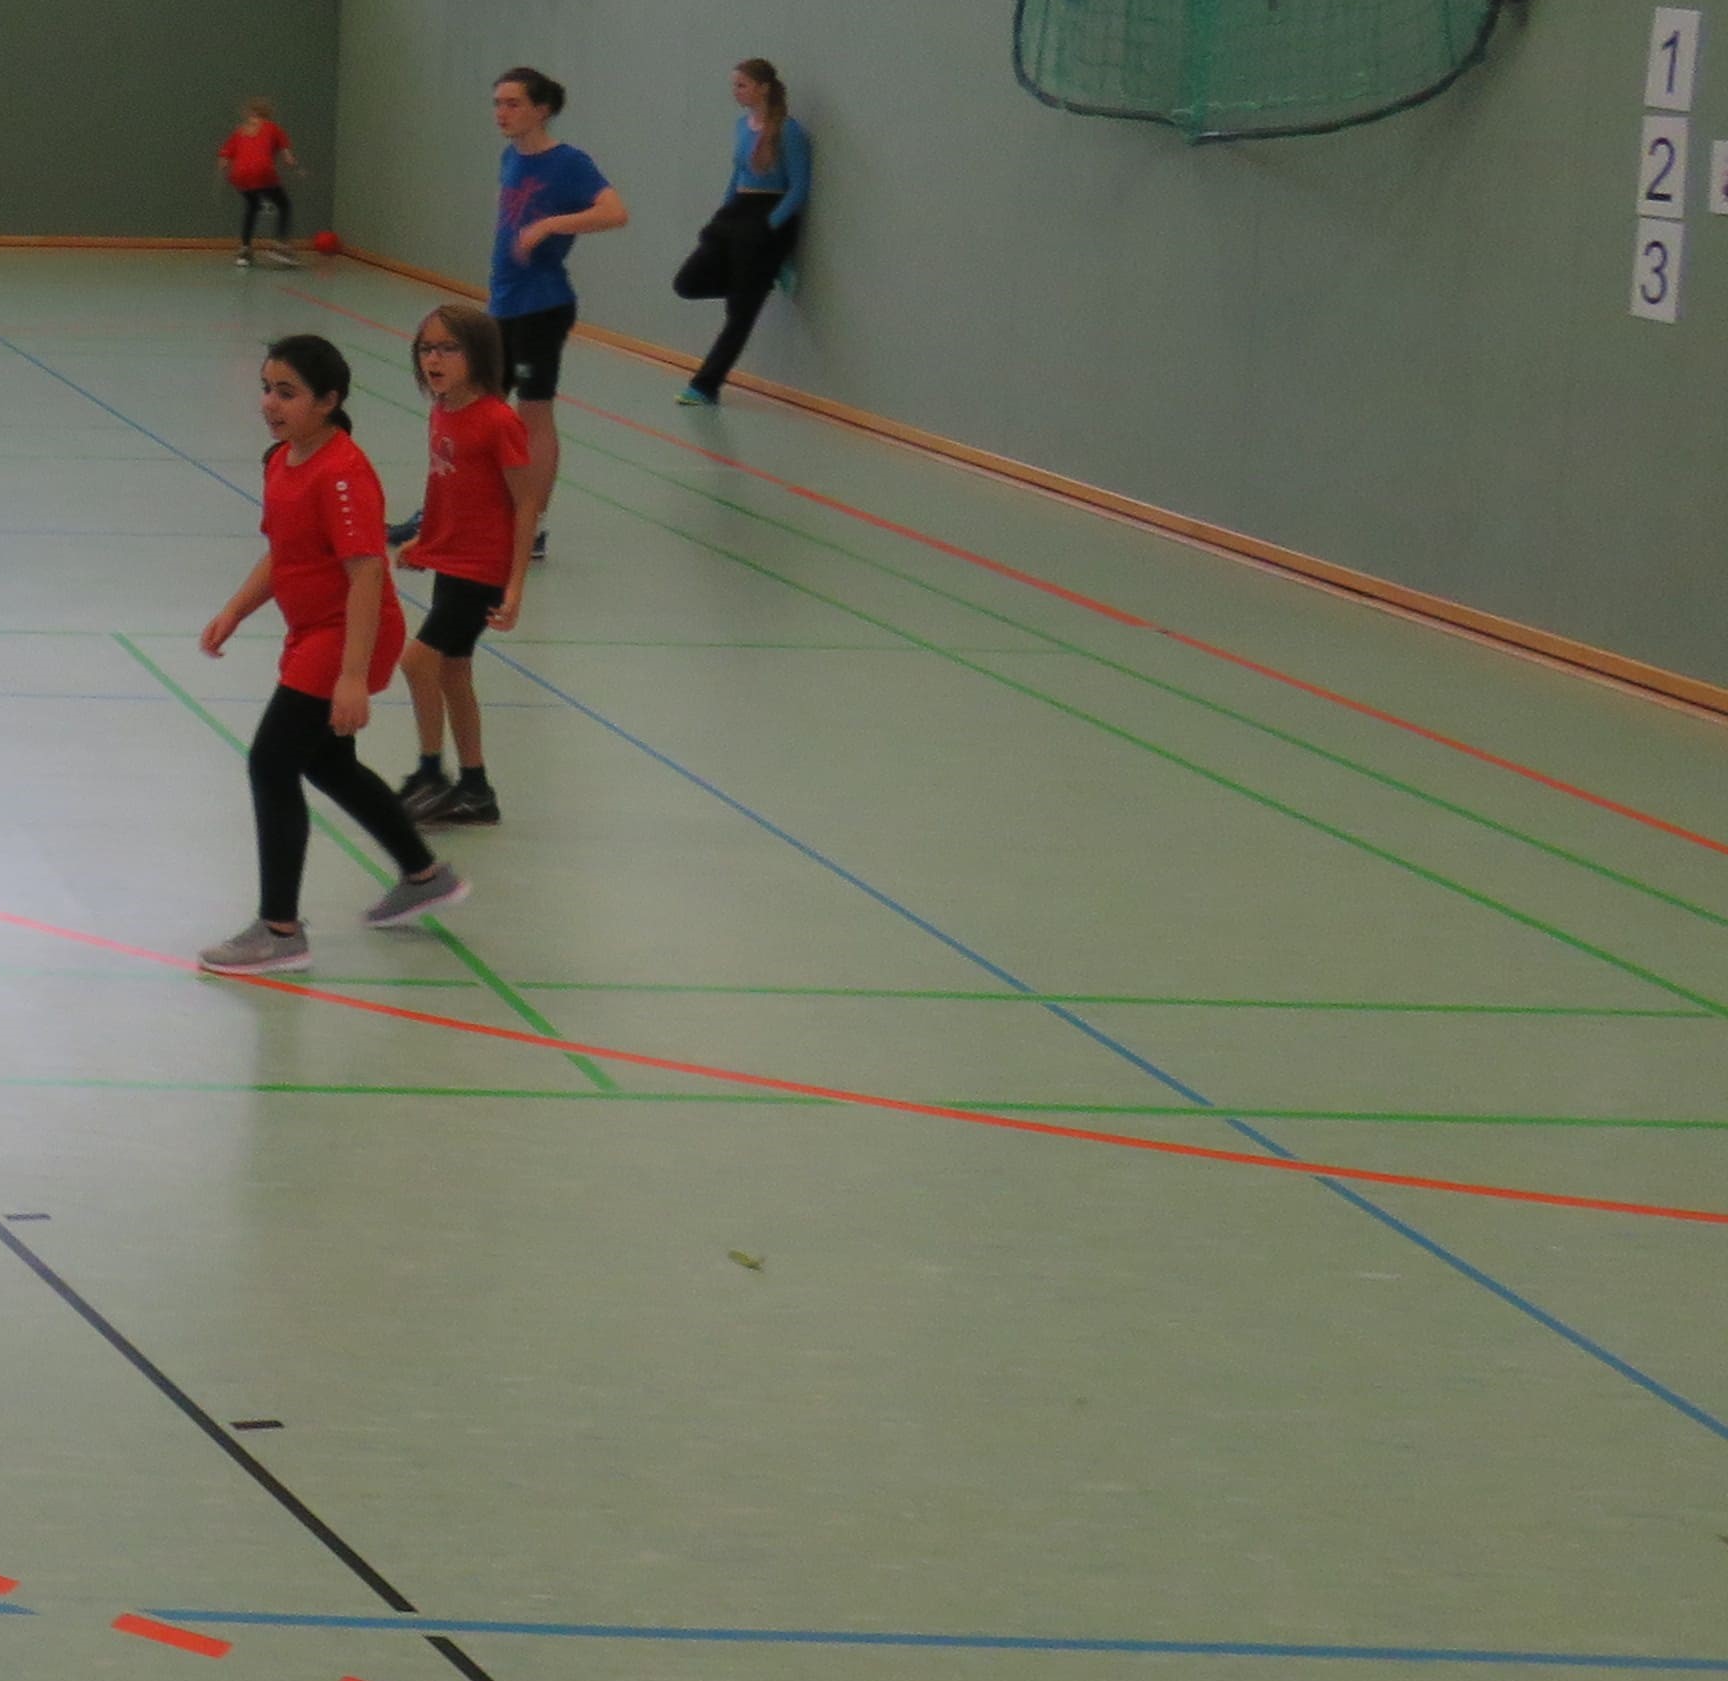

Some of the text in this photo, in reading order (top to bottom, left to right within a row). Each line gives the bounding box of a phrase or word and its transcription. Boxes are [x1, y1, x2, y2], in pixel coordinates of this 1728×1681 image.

[1661, 30, 1681, 94] 1
[1645, 137, 1676, 202] 2
[1640, 240, 1668, 304] 3
